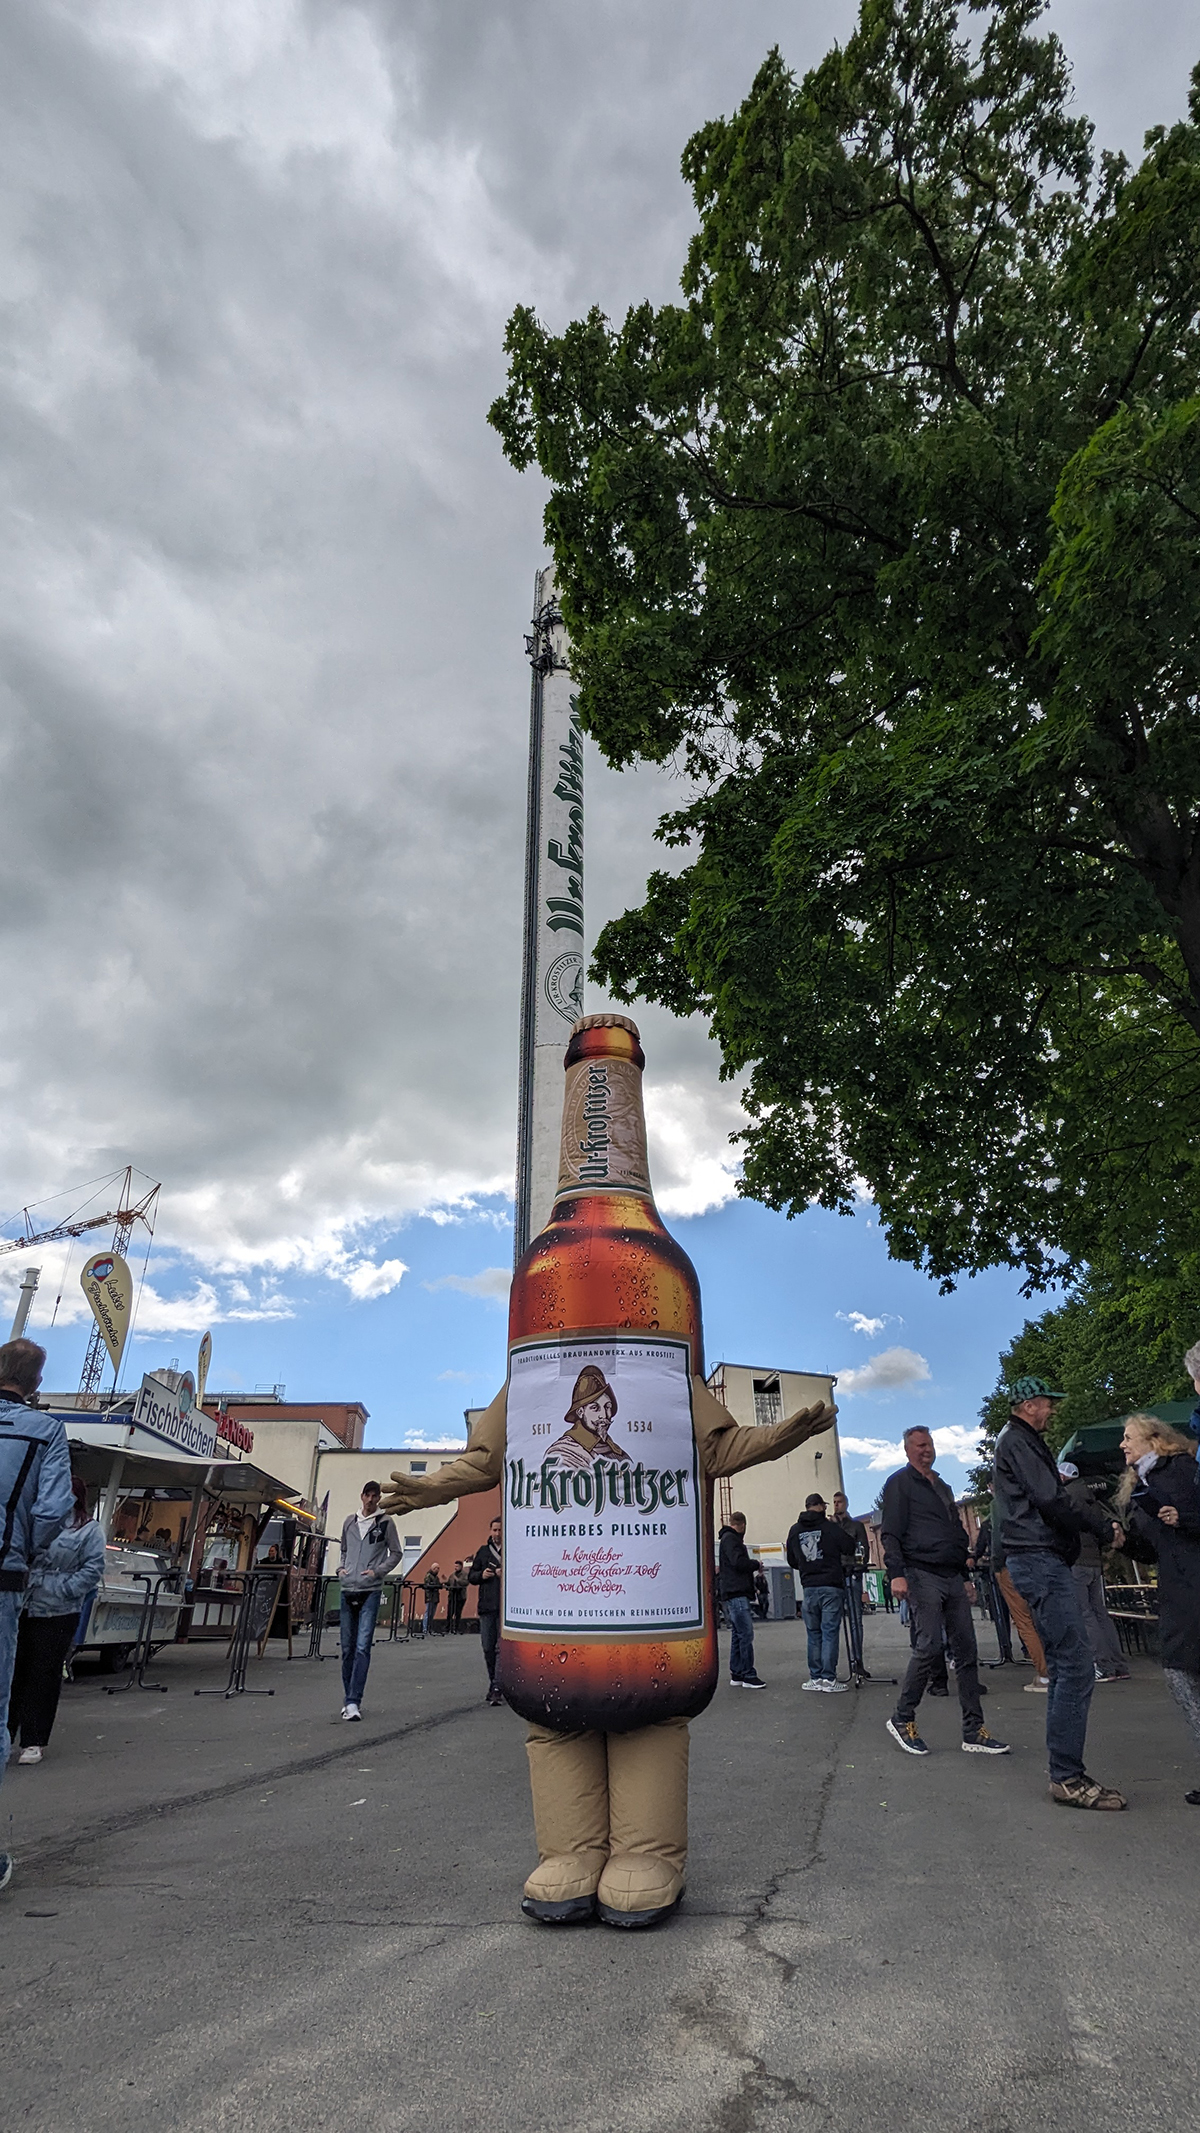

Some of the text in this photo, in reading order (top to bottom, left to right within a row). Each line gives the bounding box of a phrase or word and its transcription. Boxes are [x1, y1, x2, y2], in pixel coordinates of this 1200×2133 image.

[578, 1066, 612, 1180] Ur-Krostitzer
[517, 1349, 676, 1365] TRADITIONELLES BRAUHANDWERK AUS KROSTITZ
[138, 1387, 214, 1457] Fischbrötchen
[532, 1423, 551, 1435] SEIT
[627, 1421, 653, 1433] 1534
[509, 1457, 689, 1517] Ur-Krostitzer
[526, 1523, 668, 1537] FEINHERBES PILSNER
[561, 1546, 624, 1564] In königlicher
[531, 1562, 568, 1578] Tradition
[569, 1565, 590, 1577] seit
[589, 1563, 624, 1580] Gustav
[633, 1562, 662, 1579] Adolf
[557, 1582, 576, 1593] von
[535, 1608, 554, 1617] NACH
[557, 1608, 574, 1617] DEM
[578, 1609, 626, 1617] DEUTSCHEN
[630, 1606, 692, 1616] REINHEITSGEBOT
